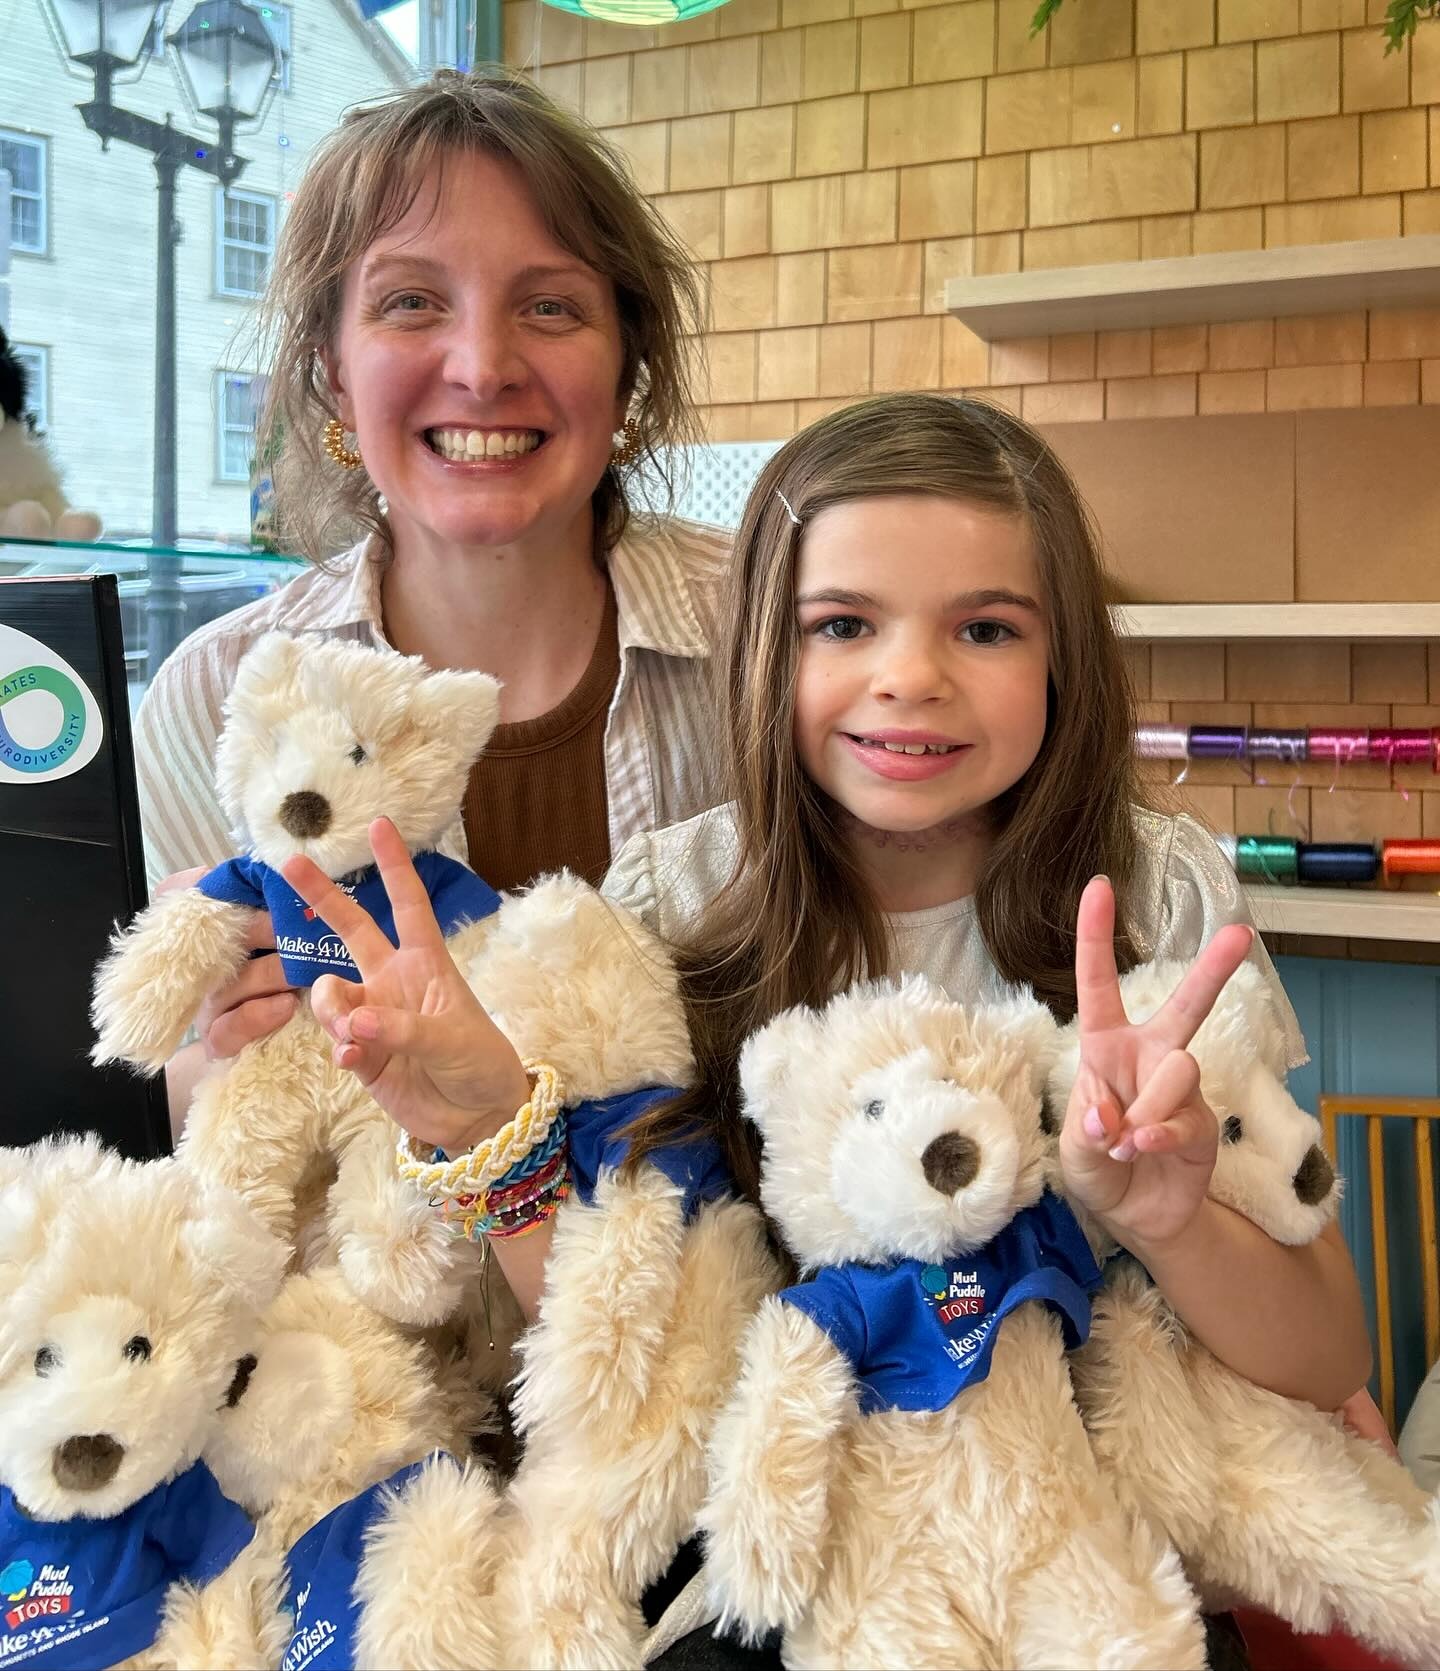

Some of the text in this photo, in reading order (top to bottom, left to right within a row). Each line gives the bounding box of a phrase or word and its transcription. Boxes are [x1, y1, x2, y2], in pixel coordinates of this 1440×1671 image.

[0, 673, 36, 698] ATES
[276, 934, 352, 960] Make-A-W
[953, 1271, 977, 1284] Mud
[949, 1285, 986, 1298] Puddle
[941, 1300, 979, 1321] TOYS
[39, 1565, 70, 1581] Mud
[30, 1581, 74, 1597] Puddle
[12, 1598, 62, 1622] TOYS
